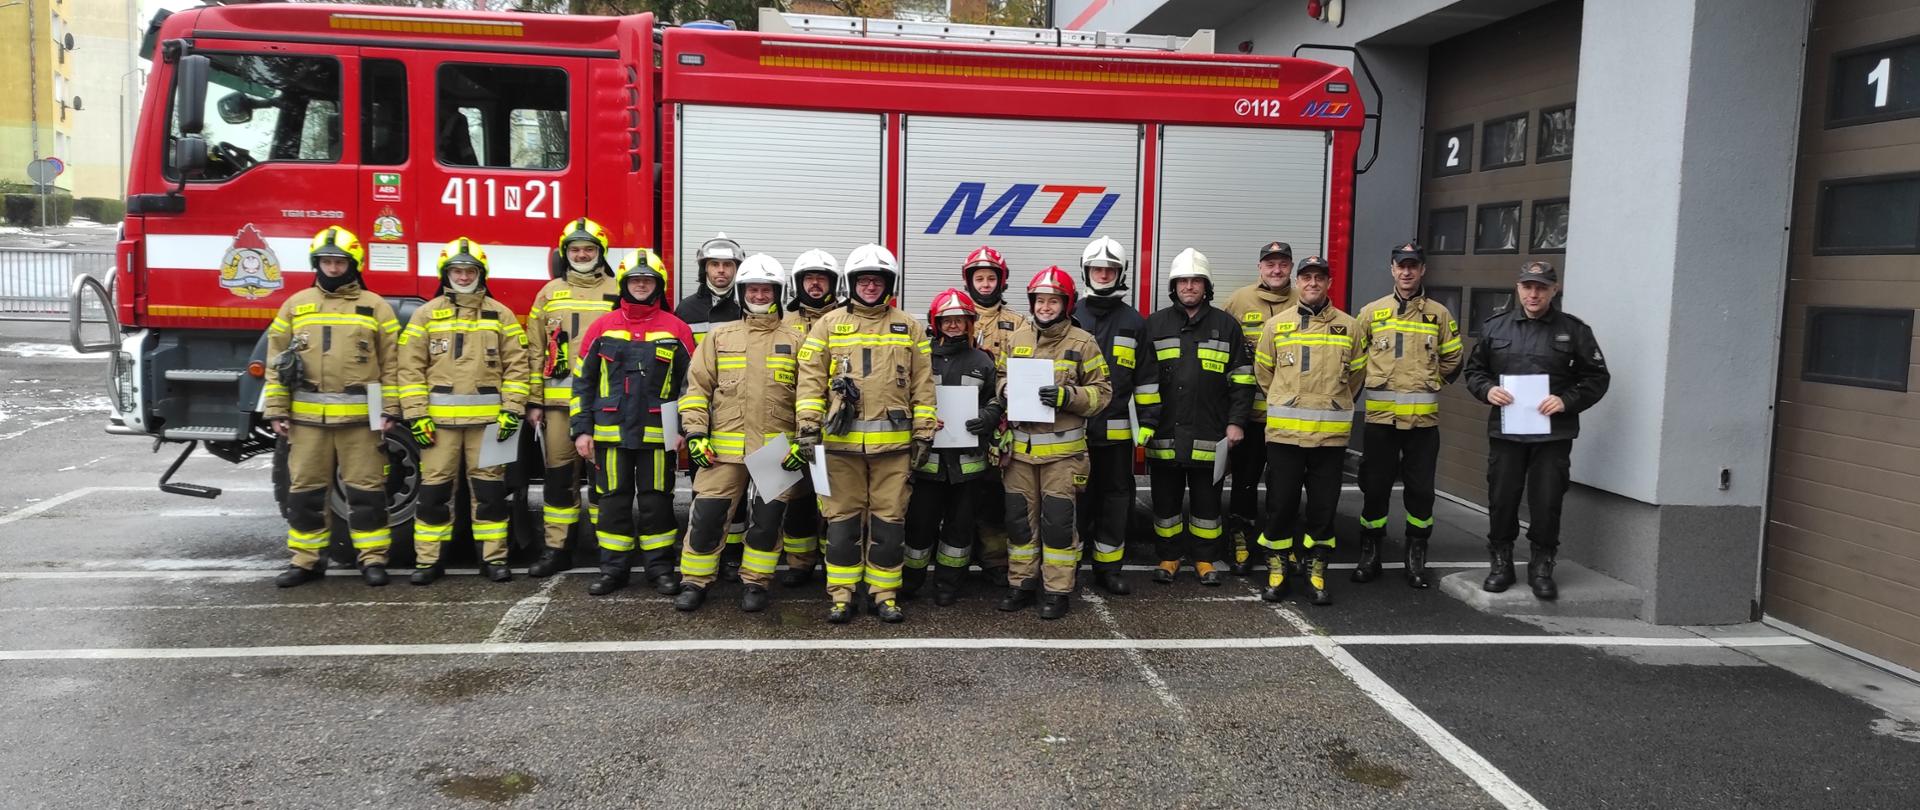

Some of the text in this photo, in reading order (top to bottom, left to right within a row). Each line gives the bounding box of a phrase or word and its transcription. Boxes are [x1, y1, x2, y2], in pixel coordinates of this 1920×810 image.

[1868, 58, 1890, 107] 1
[1251, 99, 1280, 117] 112
[1446, 136, 1460, 167] 2
[441, 177, 560, 218] 411 N 21
[836, 325, 852, 333] OSP
